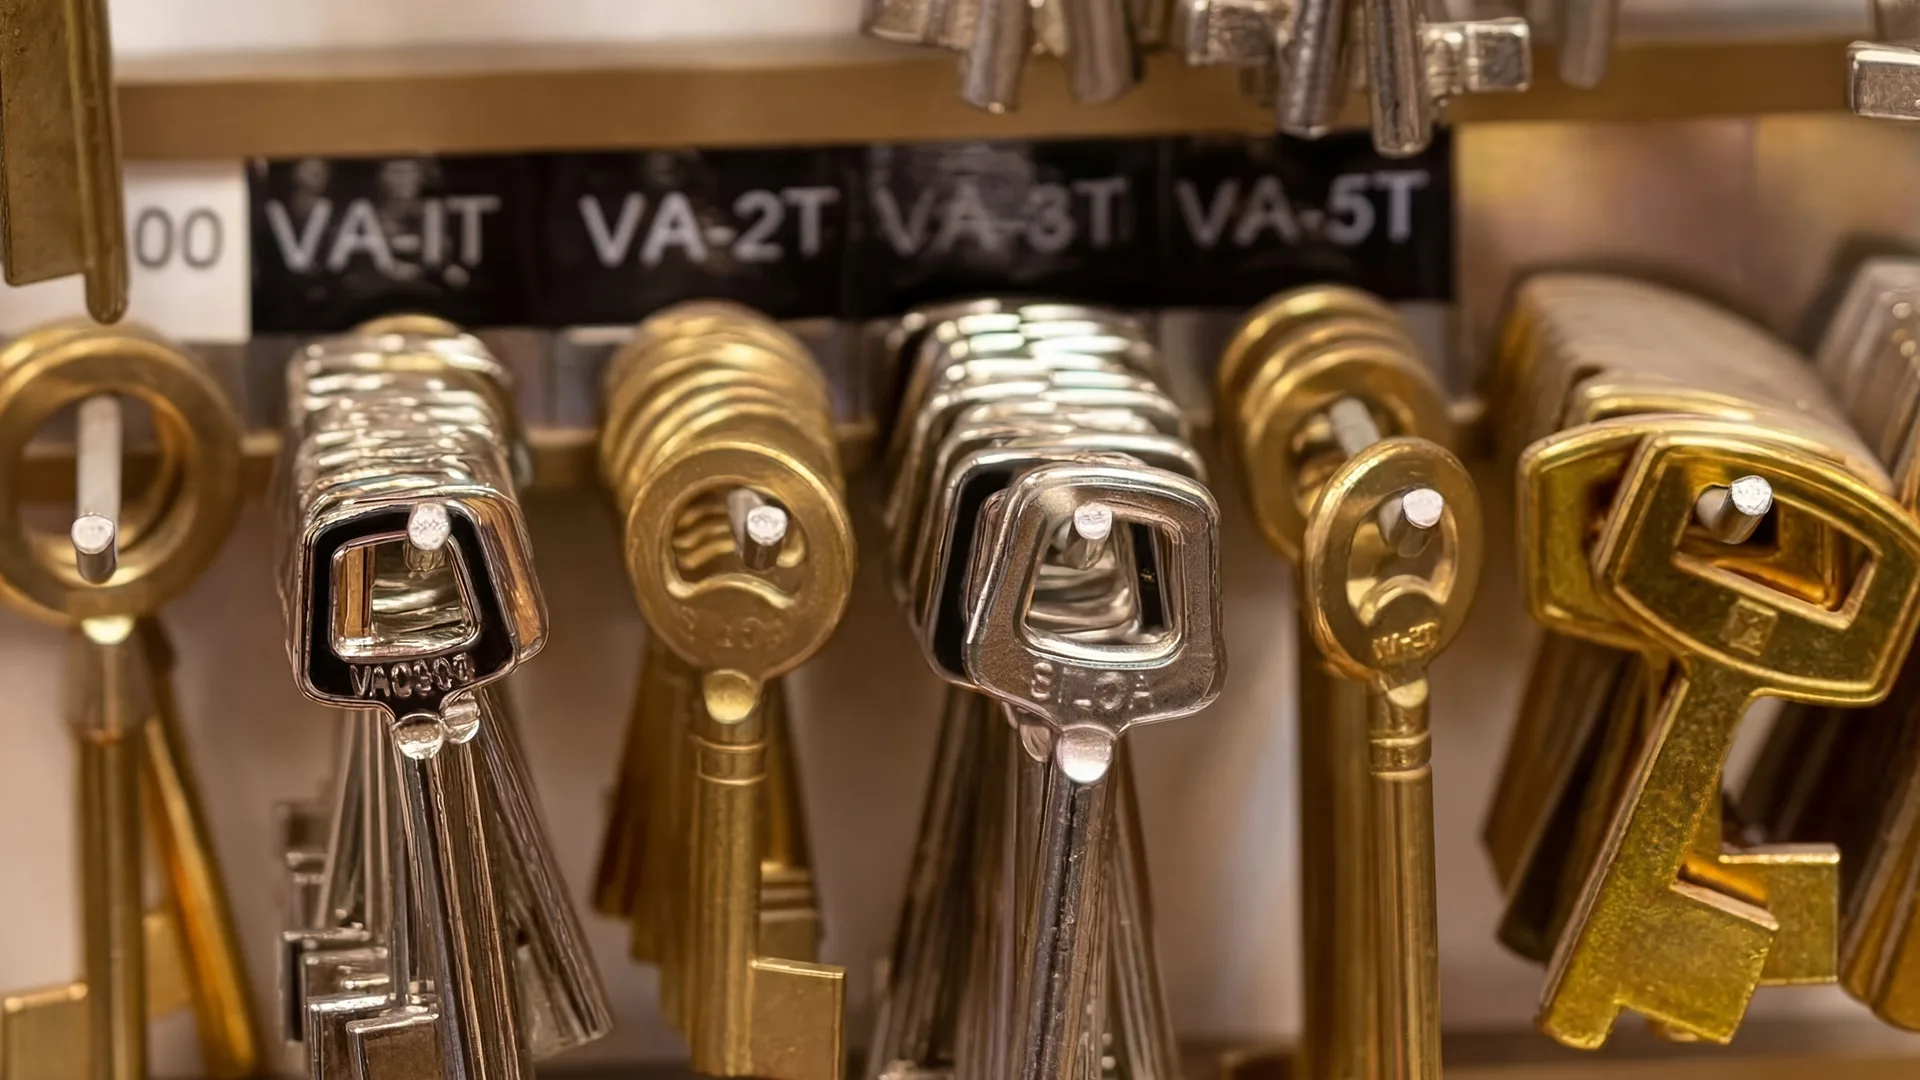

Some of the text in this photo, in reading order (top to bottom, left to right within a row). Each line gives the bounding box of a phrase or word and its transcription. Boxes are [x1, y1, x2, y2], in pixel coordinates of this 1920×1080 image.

[580, 187, 840, 267] VA-2T
[874, 176, 1128, 255] VA-3T
[1176, 170, 1429, 247] VA-5T
